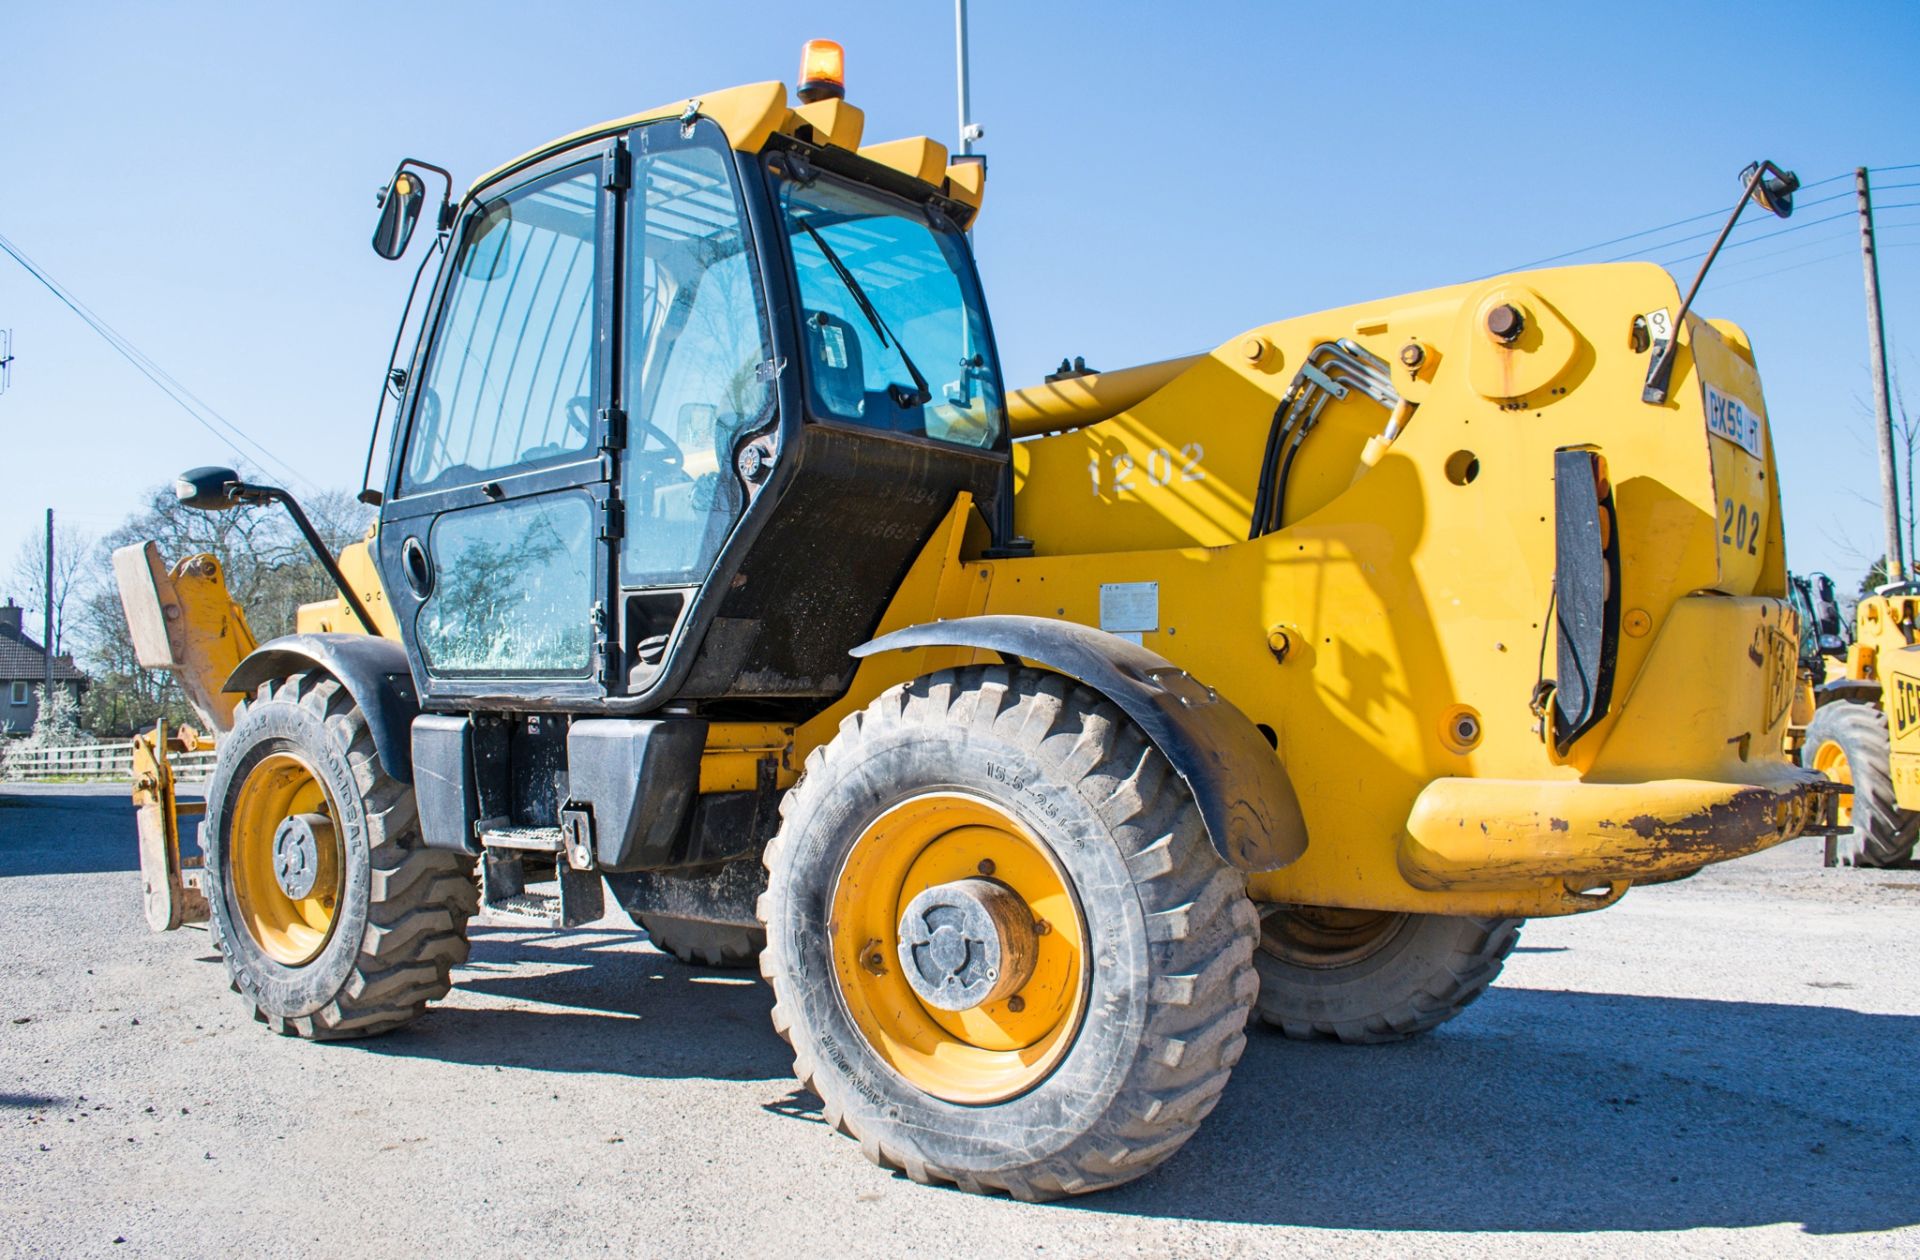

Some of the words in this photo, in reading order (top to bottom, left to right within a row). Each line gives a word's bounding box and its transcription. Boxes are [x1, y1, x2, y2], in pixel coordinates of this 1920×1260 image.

[1710, 391, 1742, 440] DX59
[1088, 442, 1205, 496] 1202
[1722, 497, 1760, 556] 202
[821, 1034, 886, 1105] ARMOUR
